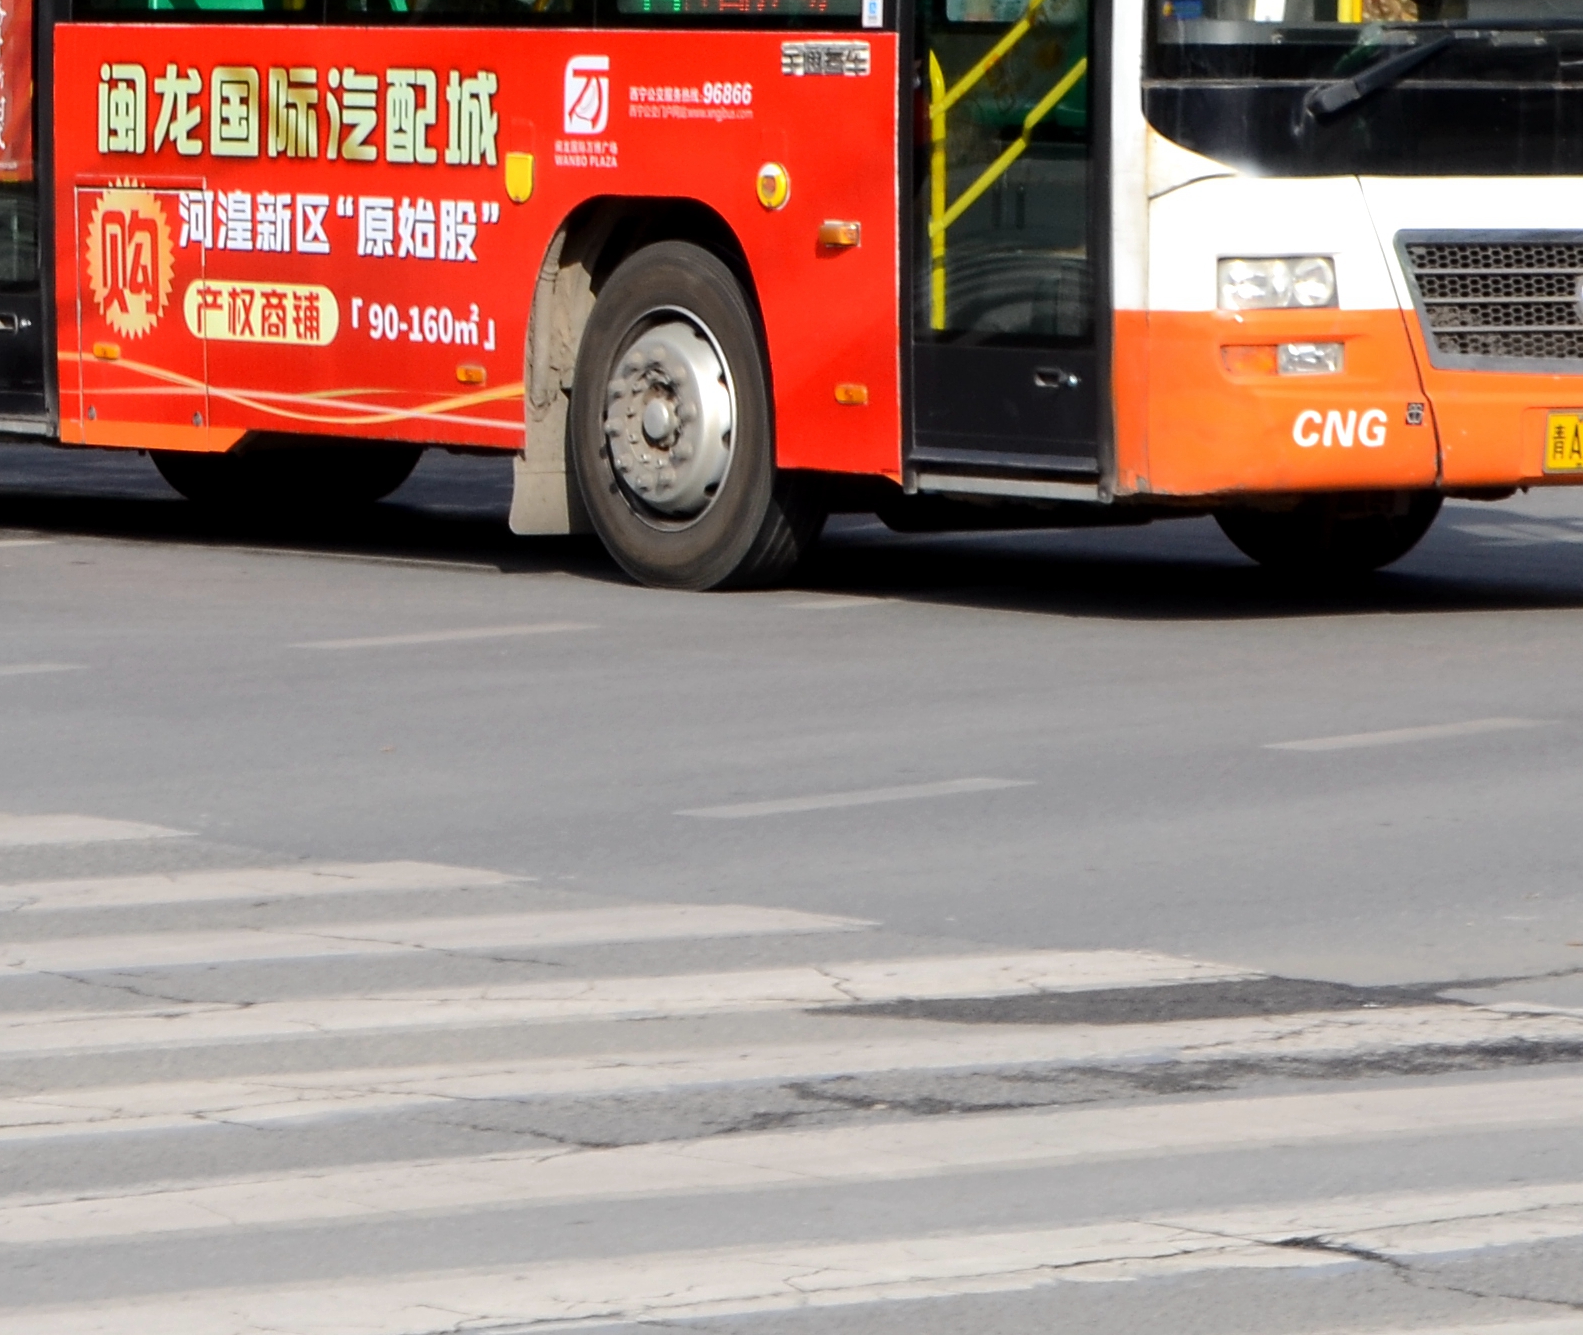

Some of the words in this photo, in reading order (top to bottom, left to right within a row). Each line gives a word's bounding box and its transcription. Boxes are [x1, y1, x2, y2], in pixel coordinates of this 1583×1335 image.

[97, 63, 499, 166] 闽龙国际汽配城
[178, 189, 500, 262] 河湟新区“原始股”
[101, 208, 161, 318] 购
[196, 286, 320, 341] 产权商铺
[1292, 409, 1388, 447] CNG
